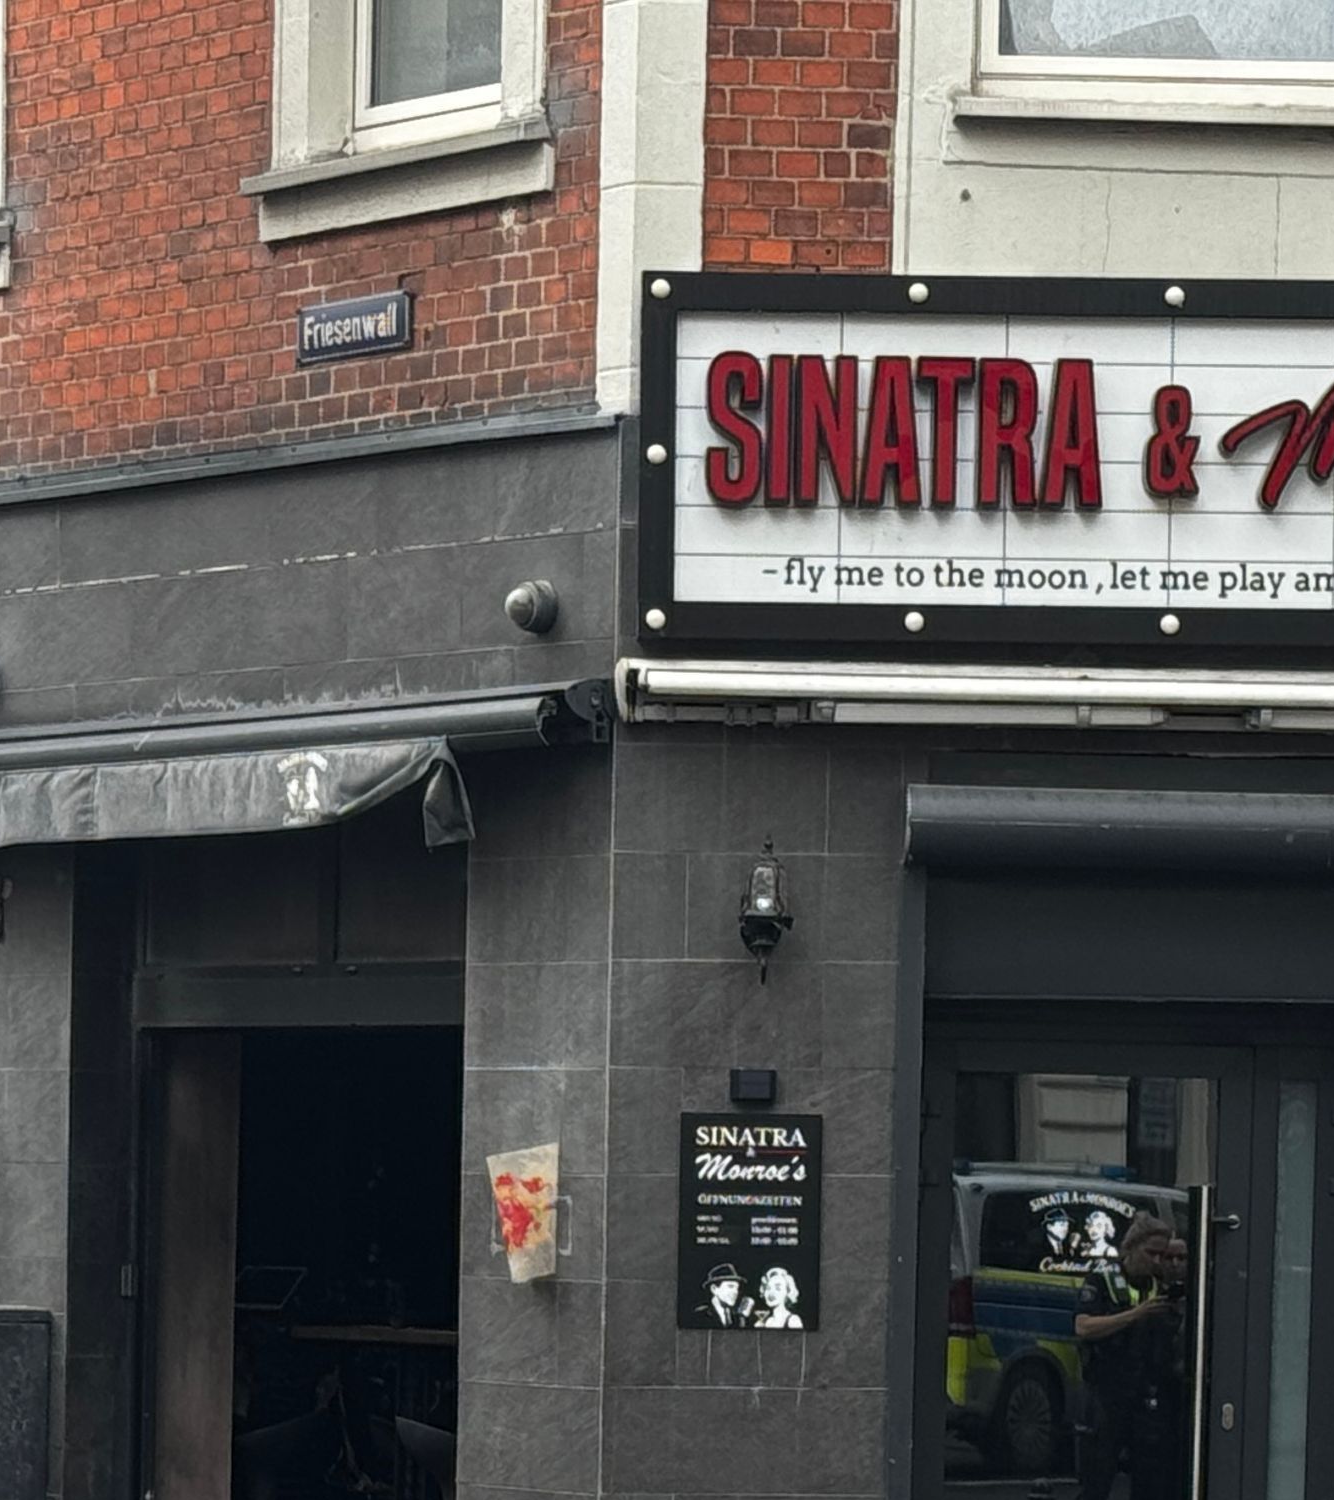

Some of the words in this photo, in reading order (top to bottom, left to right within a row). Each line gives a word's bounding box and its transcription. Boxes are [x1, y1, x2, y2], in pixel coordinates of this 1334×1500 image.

[303, 301, 398, 351] Friesenwall
[705, 350, 1102, 510] SINATRA
[1144, 385, 1199, 501] &
[834, 565, 884, 587] me
[895, 564, 925, 588] to
[934, 560, 985, 588] the
[1160, 570, 1210, 591] me
[1218, 563, 1286, 599] play
[695, 1125, 807, 1148] SINATRA
